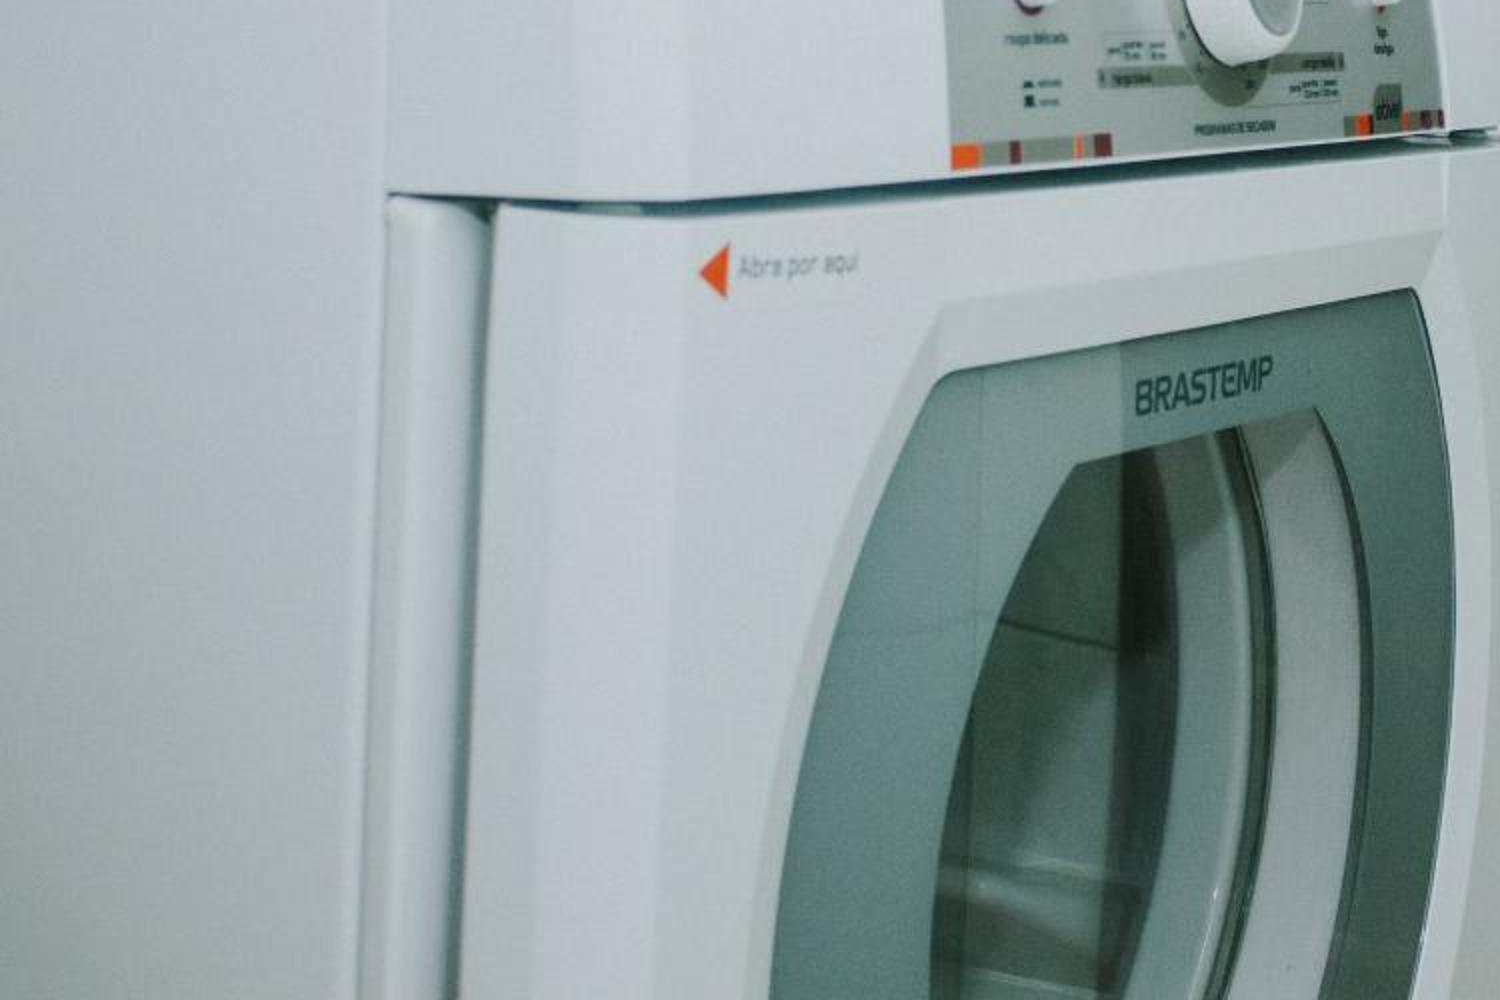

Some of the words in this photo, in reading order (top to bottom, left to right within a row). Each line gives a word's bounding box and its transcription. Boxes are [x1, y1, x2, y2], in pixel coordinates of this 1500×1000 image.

[786, 255, 818, 282] por
[823, 251, 860, 280] aqui
[1134, 353, 1275, 418] BRASTEMP
